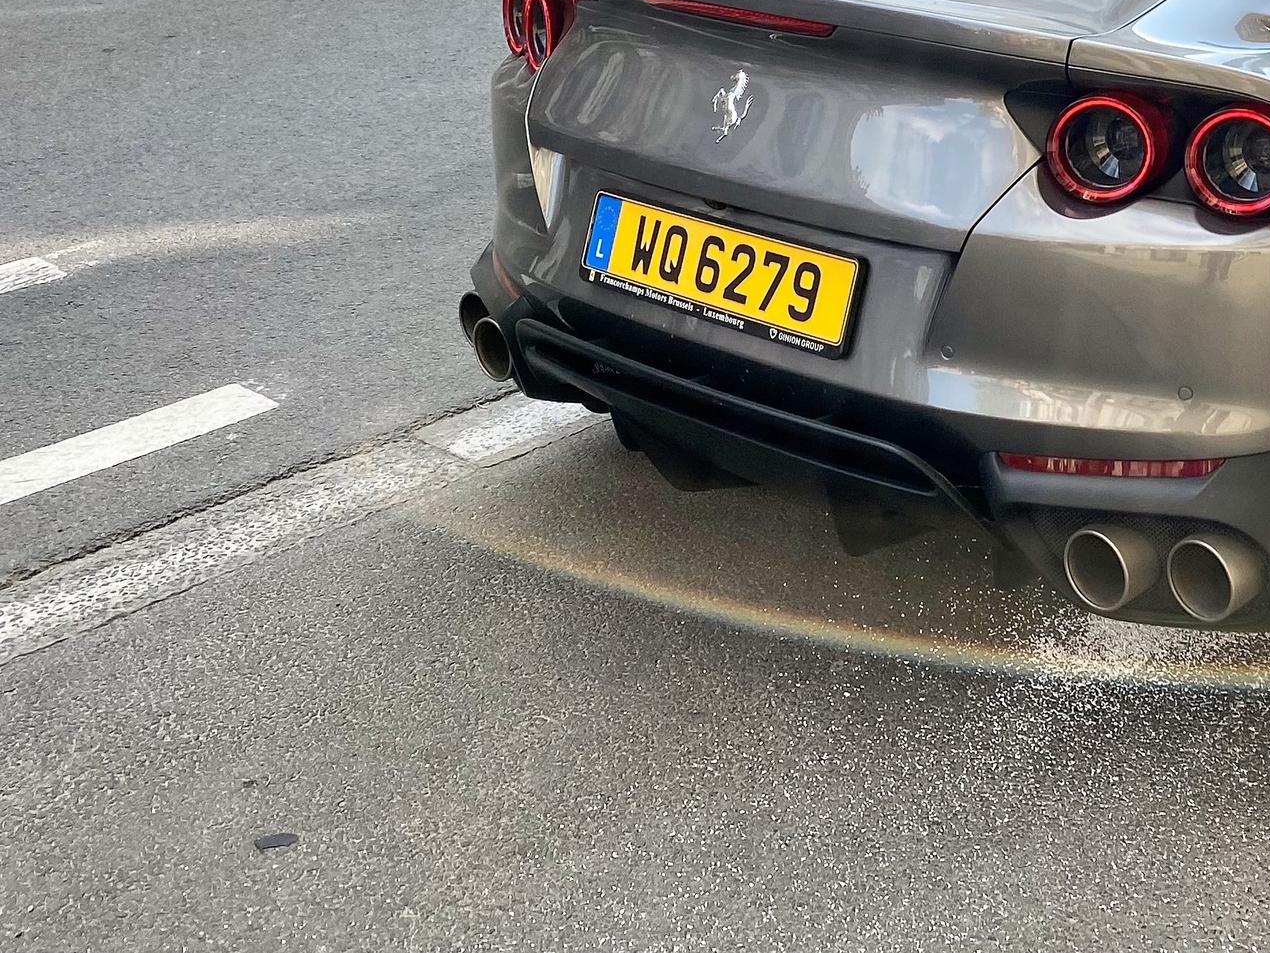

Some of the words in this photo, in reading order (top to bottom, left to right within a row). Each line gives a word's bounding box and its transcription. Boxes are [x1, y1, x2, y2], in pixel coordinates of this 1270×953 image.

[595, 238, 605, 259] L
[694, 234, 822, 323] 6279
[600, 272, 645, 296] Francorchamps
[646, 287, 667, 303] Motors
[667, 295, 694, 312] Brussels
[702, 306, 745, 329] Luxembourg
[778, 332, 801, 347] GINION
[800, 339, 825, 352] GROUP
